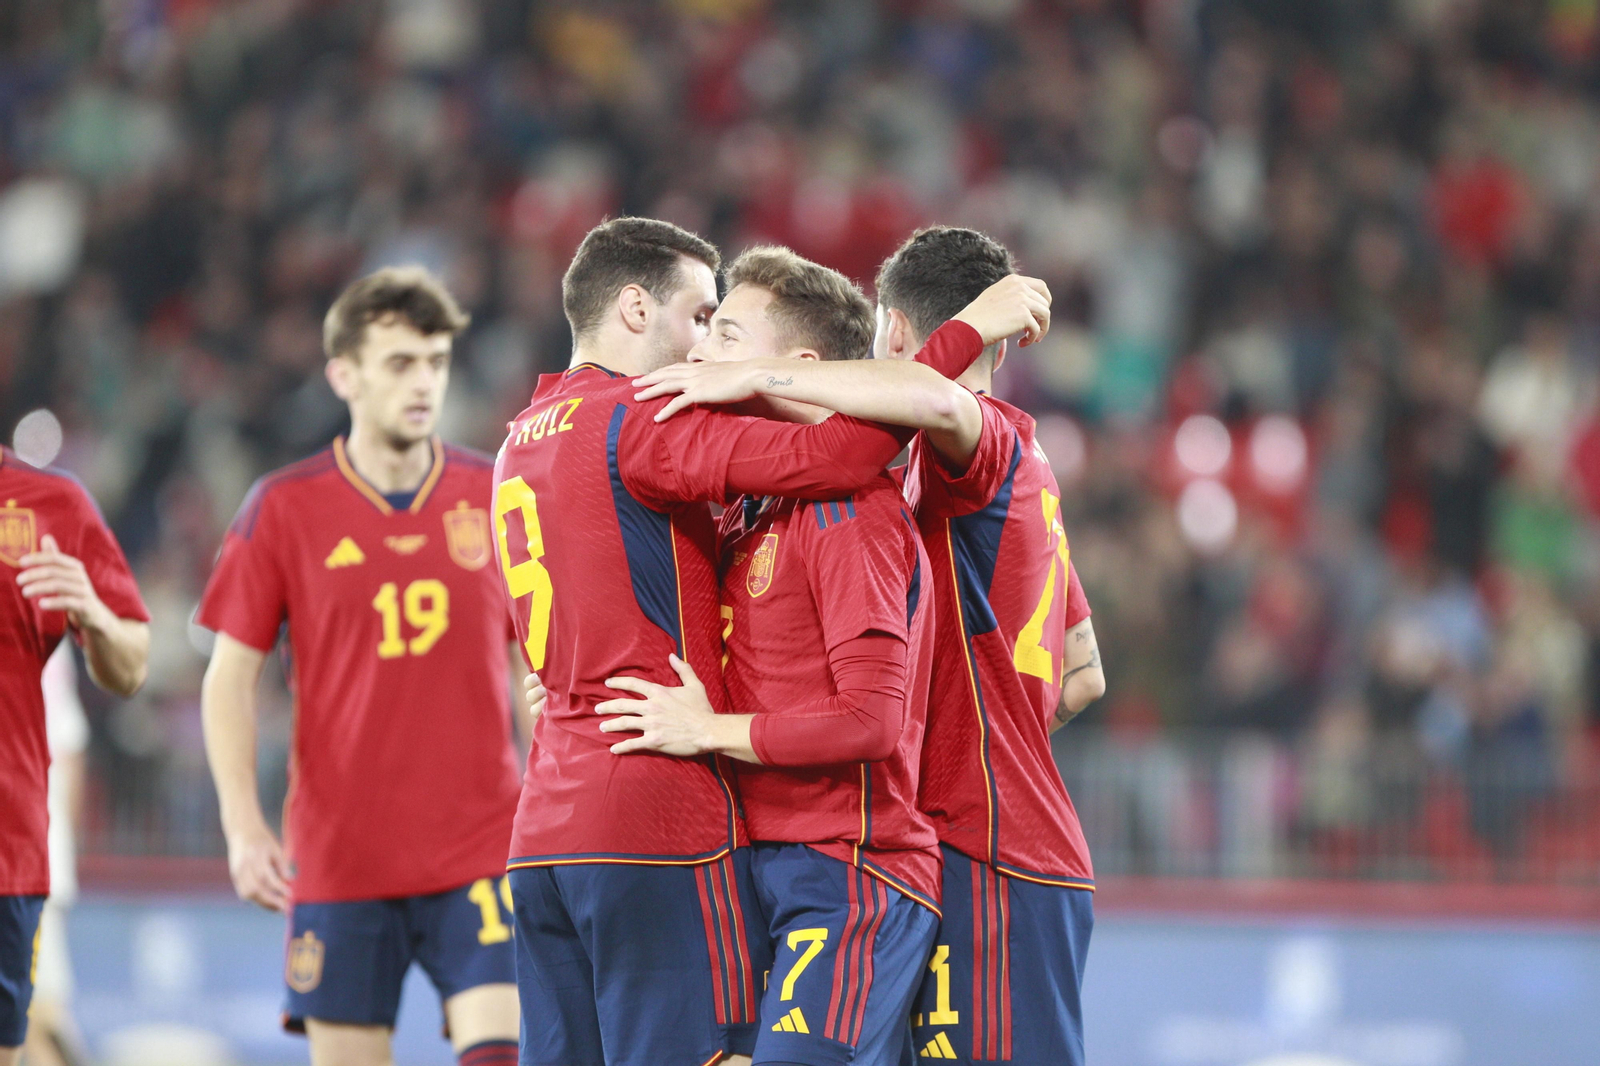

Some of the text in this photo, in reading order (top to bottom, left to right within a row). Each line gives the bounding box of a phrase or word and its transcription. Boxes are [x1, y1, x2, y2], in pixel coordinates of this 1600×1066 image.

[514, 397, 583, 446] RUIZ
[495, 475, 553, 671] 9
[372, 578, 450, 659] 19
[780, 928, 828, 1001] 7
